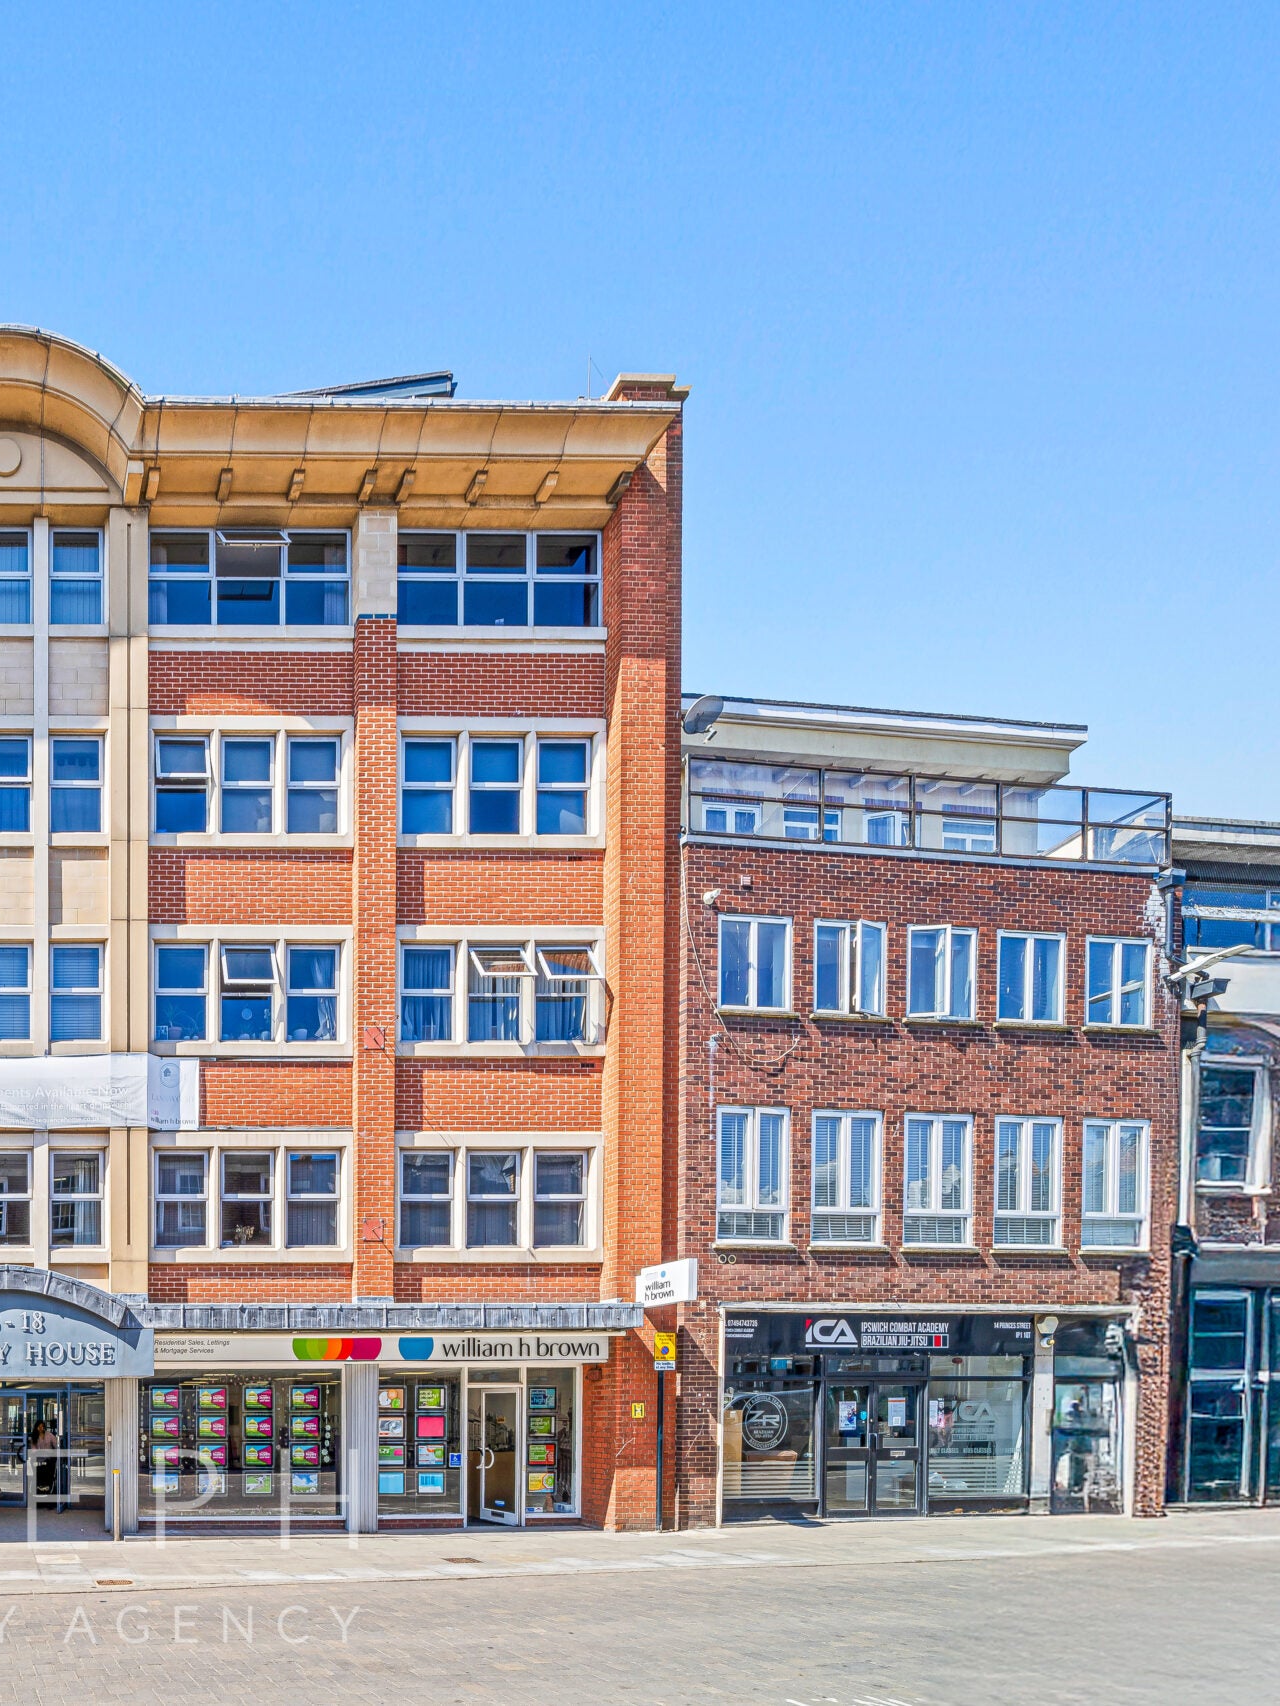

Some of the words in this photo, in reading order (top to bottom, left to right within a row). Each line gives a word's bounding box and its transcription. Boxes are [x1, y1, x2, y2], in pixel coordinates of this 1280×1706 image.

[645, 1280, 671, 1292] william
[645, 1291, 650, 1300] h
[651, 1288, 674, 1300] brown
[20, 1310, 43, 1331] 18
[861, 1322, 889, 1333] IPSWICH
[889, 1322, 917, 1333] COMBAT
[918, 1322, 949, 1333] ACADEMY
[207, 1339, 231, 1347] Lettings
[443, 1337, 513, 1357] william
[519, 1337, 530, 1357] h
[536, 1337, 600, 1357] brown
[862, 1335, 898, 1346] BRAZILIAN
[898, 1335, 928, 1347] JIU-JITSU
[25, 1341, 114, 1363] HOUSE
[160, 1347, 187, 1355] Mortgage
[633, 1404, 643, 1416] H
